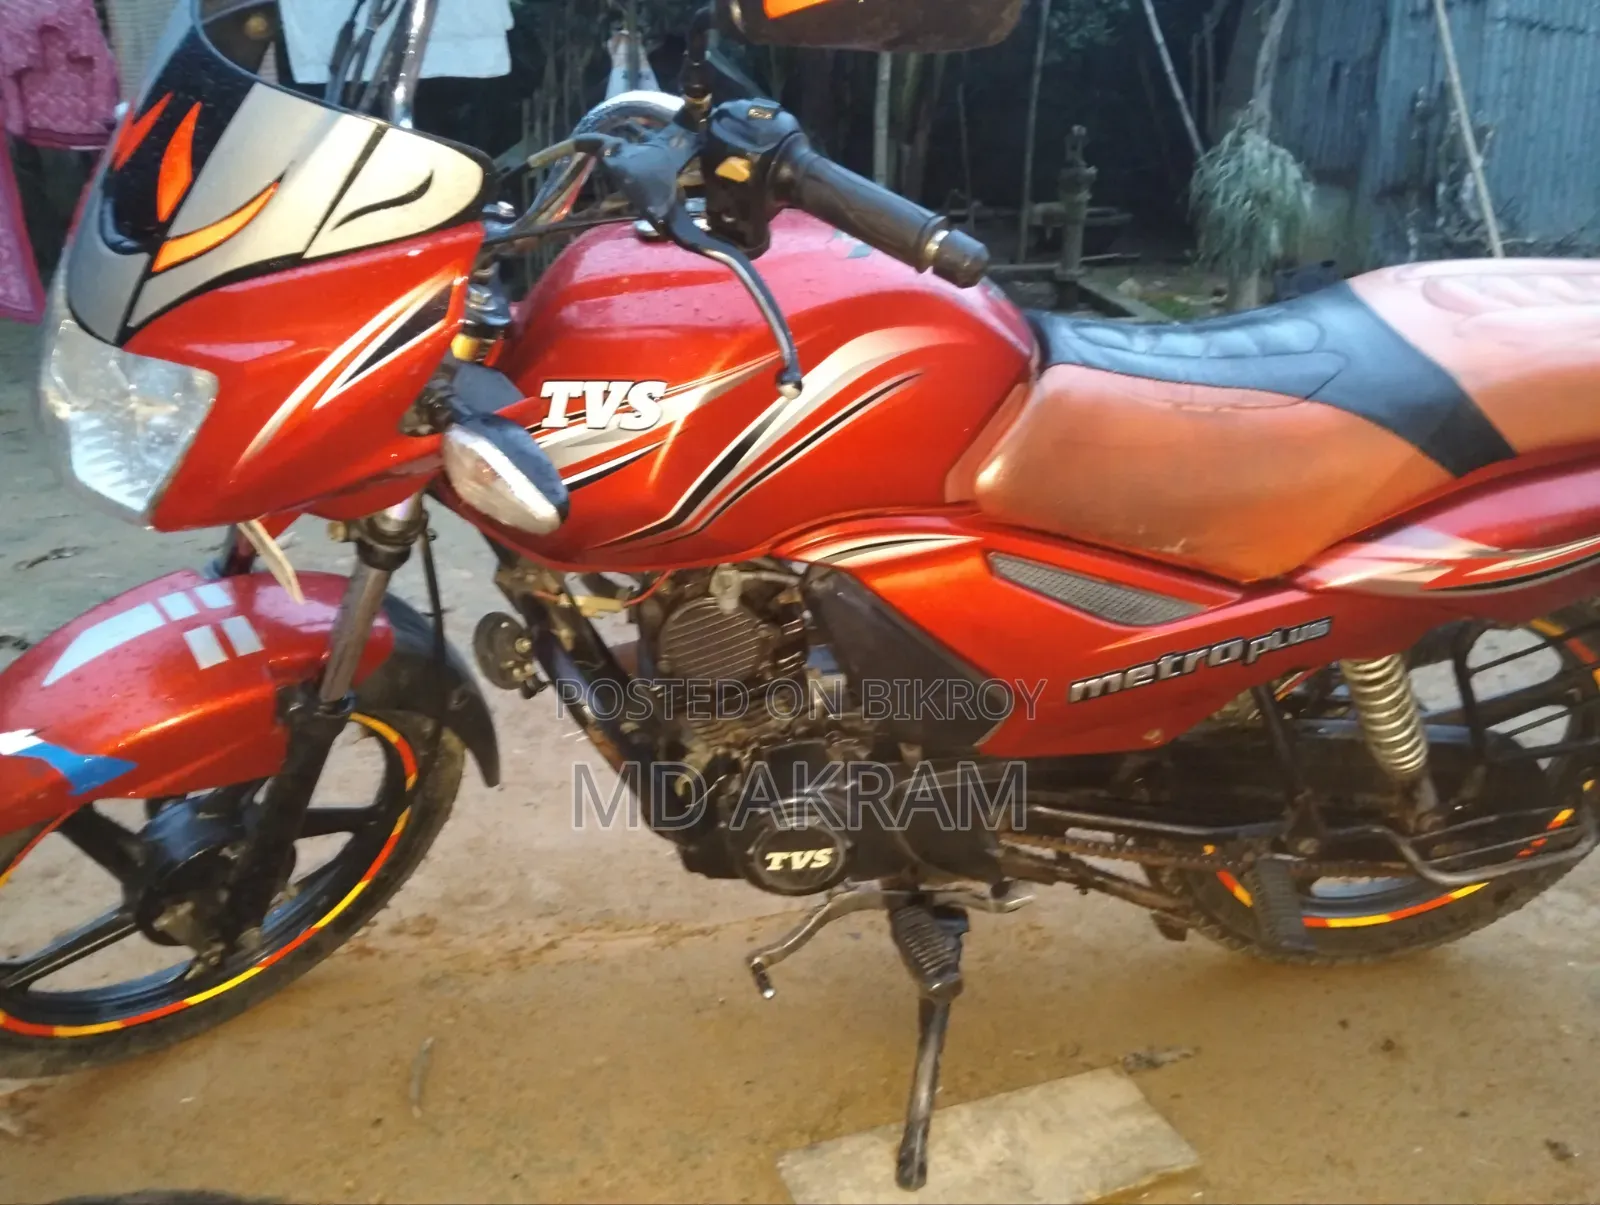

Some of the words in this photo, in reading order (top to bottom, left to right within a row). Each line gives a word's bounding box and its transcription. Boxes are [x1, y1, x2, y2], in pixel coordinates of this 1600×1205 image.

[540, 379, 668, 430] TVS
[1068, 637, 1244, 703] metro
[1242, 616, 1332, 665] plus
[764, 847, 834, 871] TVS
